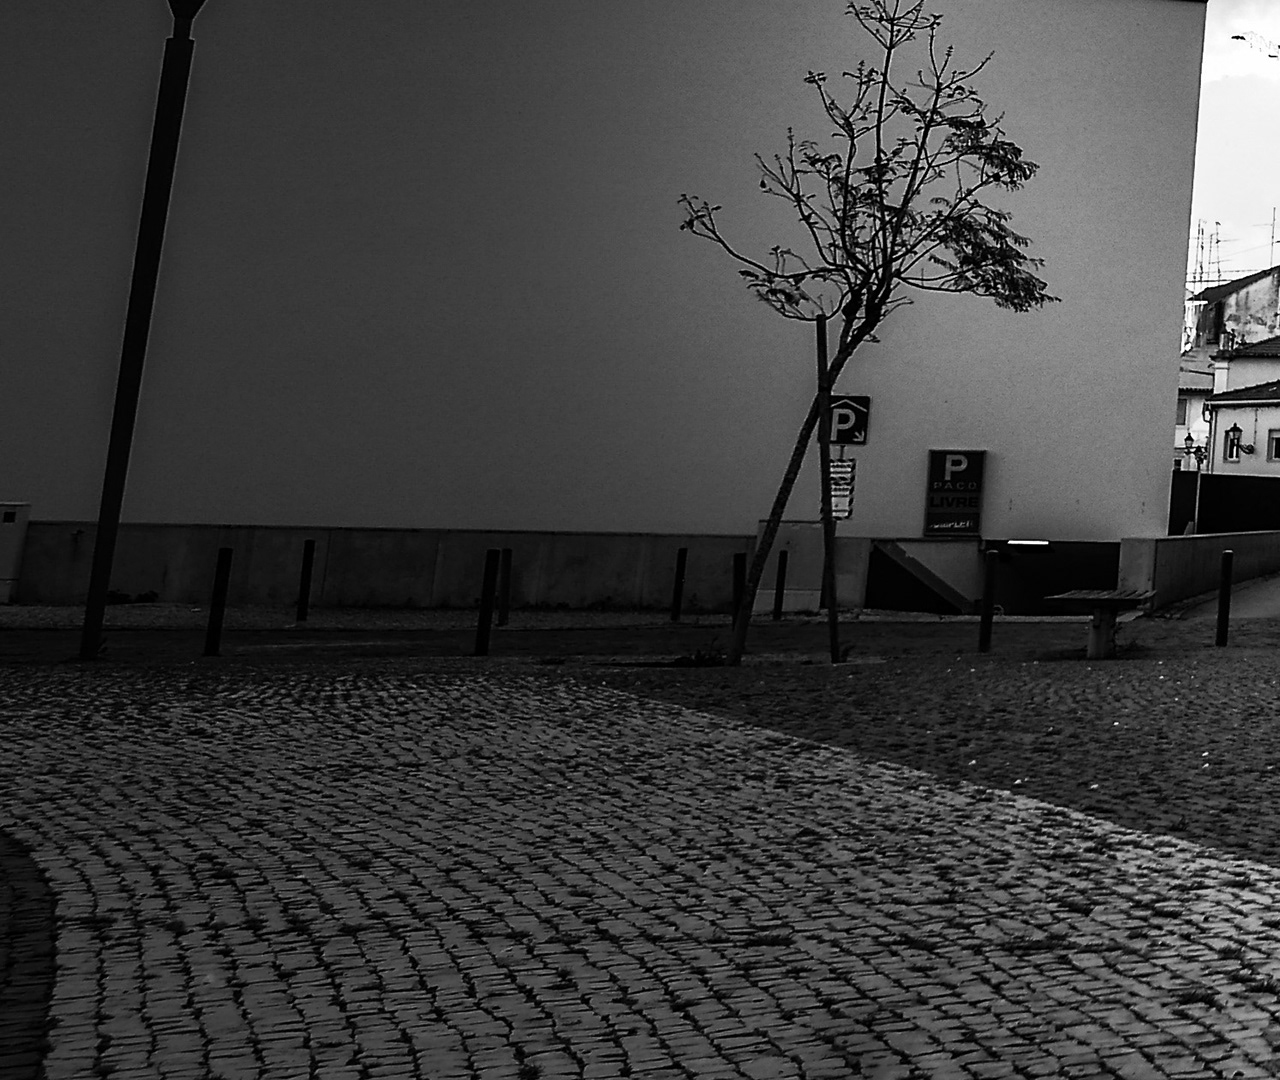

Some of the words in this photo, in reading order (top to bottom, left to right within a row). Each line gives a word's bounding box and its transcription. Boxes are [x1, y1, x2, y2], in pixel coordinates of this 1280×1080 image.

[830, 408, 856, 441] P
[944, 453, 969, 481] P
[930, 497, 978, 508] LIVRE
